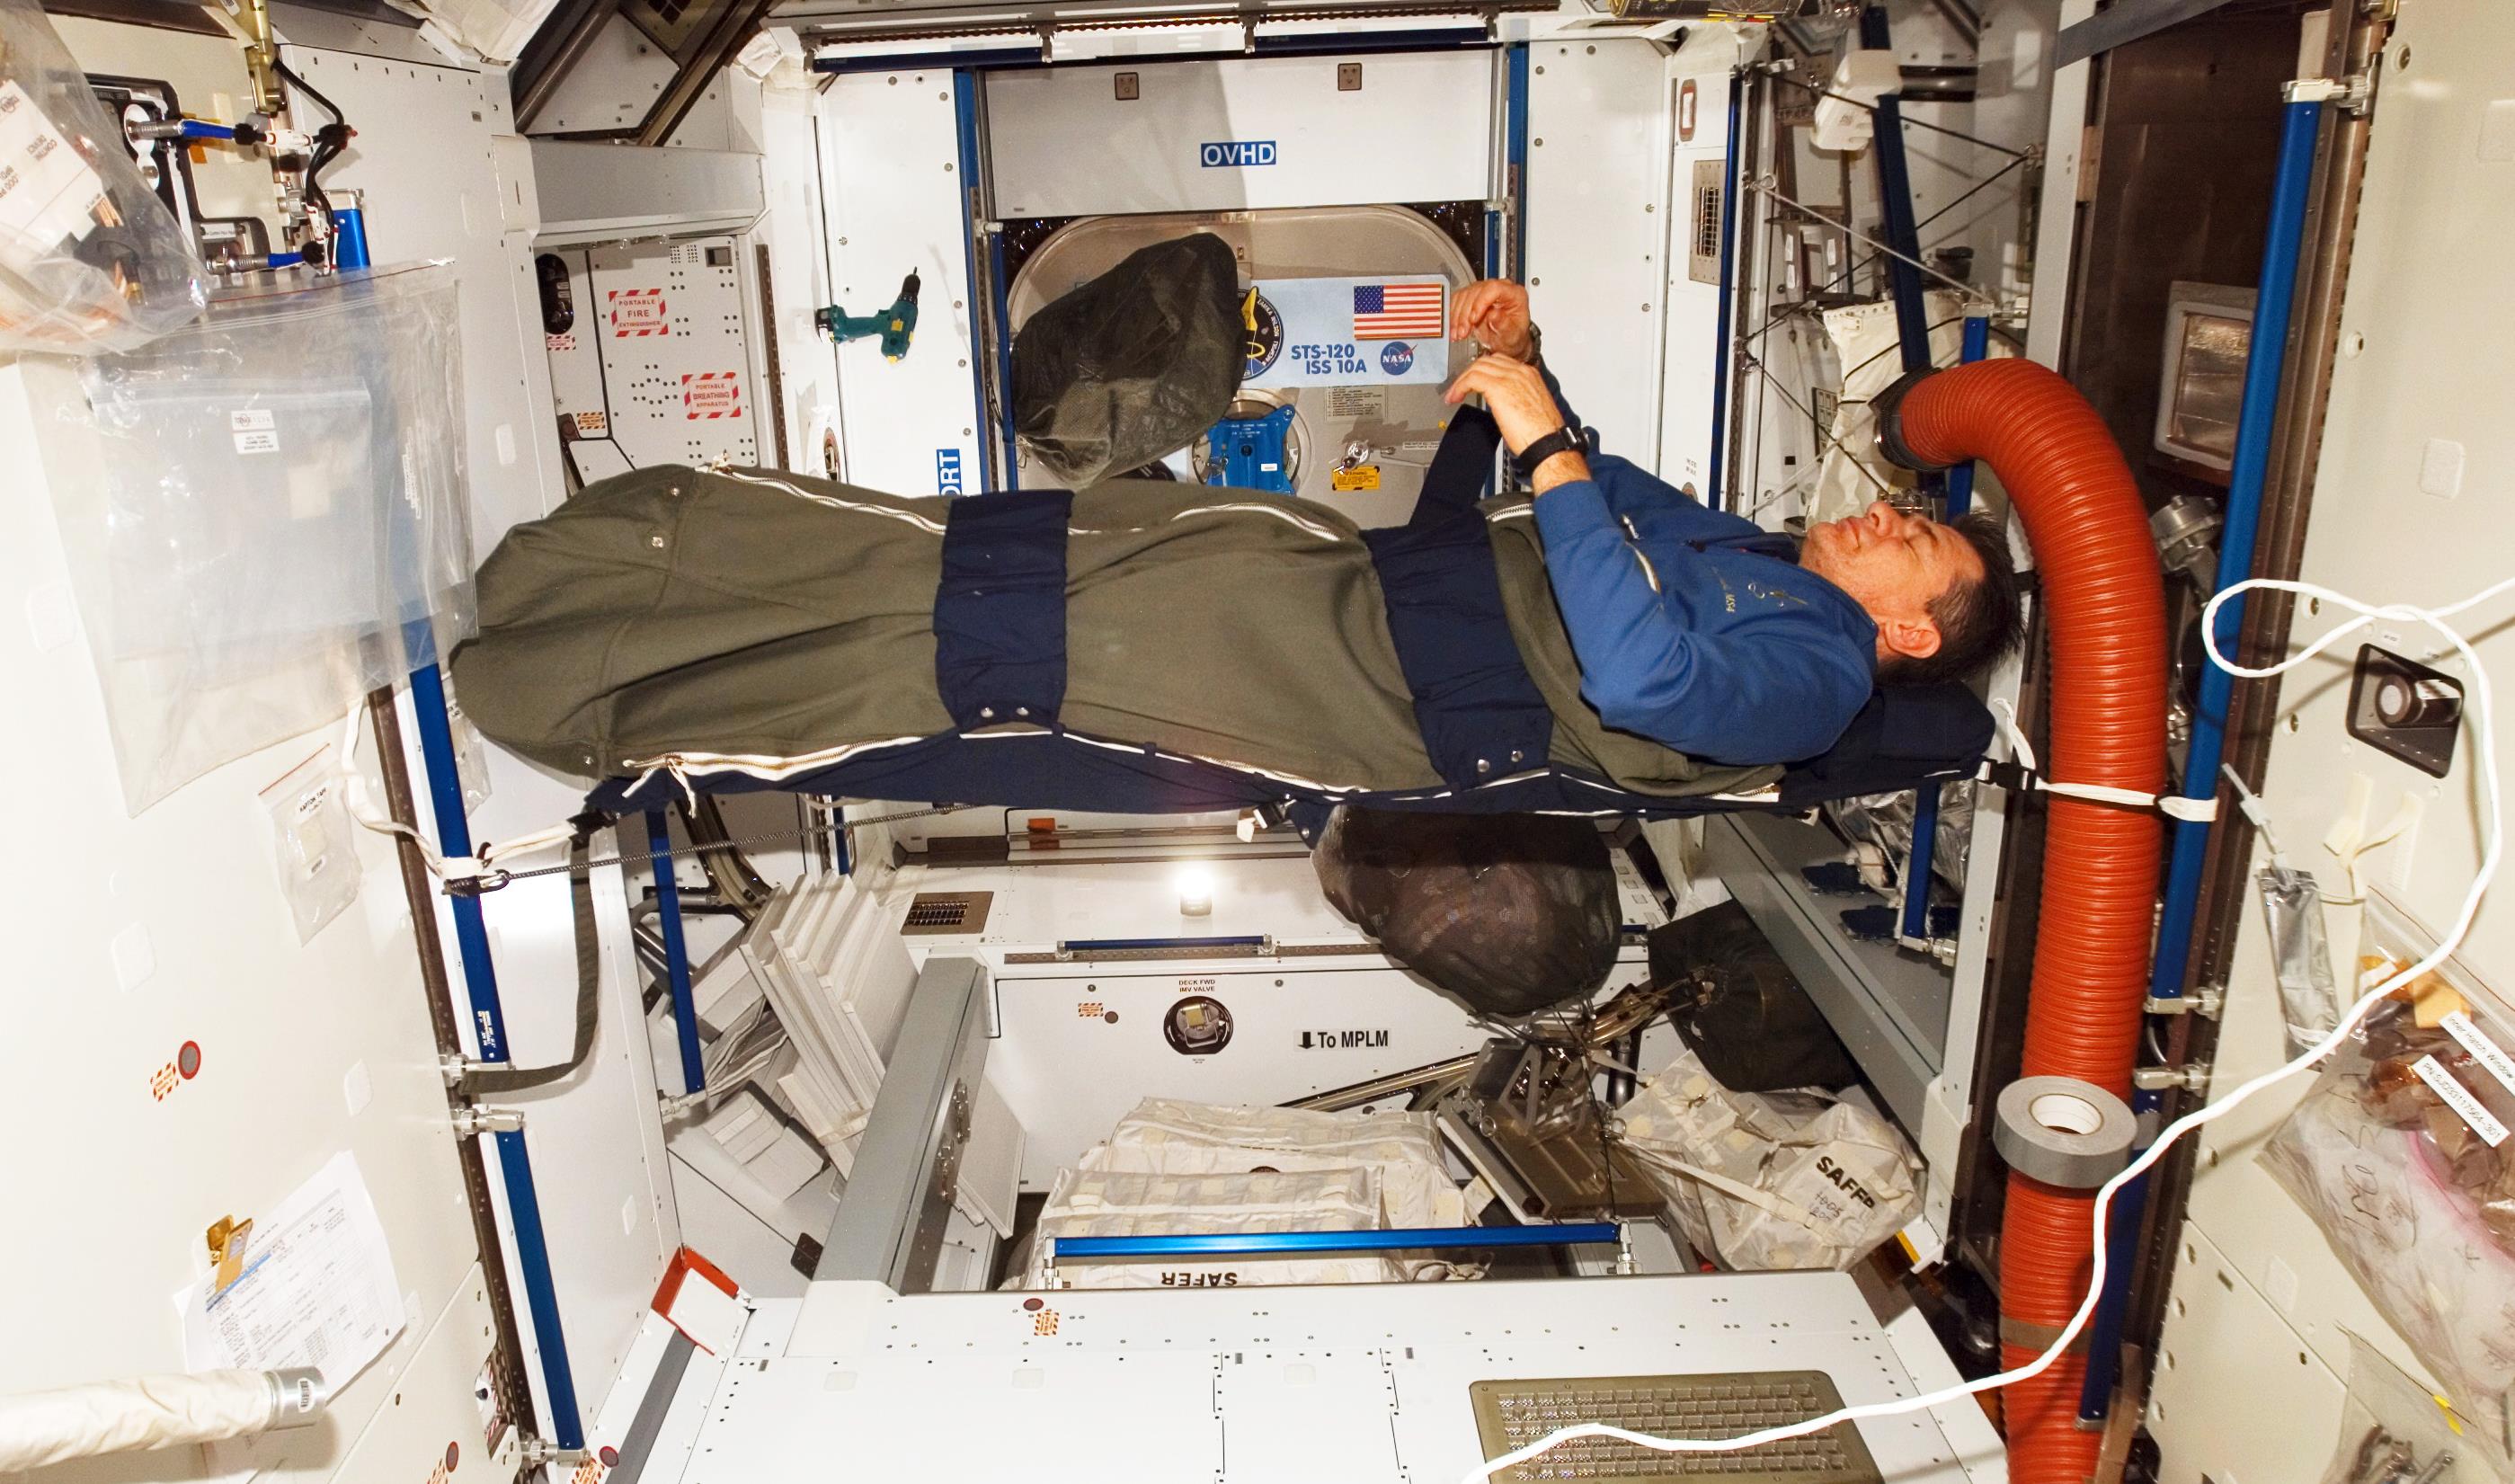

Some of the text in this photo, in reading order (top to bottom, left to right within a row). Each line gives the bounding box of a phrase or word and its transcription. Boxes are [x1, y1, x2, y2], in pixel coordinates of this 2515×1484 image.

[1204, 144, 1275, 165] OVHD
[618, 298, 655, 307] PORTABLE
[627, 309, 650, 317] FIRE
[1291, 343, 1355, 360] STS-120
[1382, 354, 1411, 364] NASA
[1306, 359, 1366, 375] ISS 10A
[693, 392, 730, 400] BREATHING
[1318, 1030, 1388, 1048] To MPLM
[1161, 1272, 1238, 1287] SAFER
